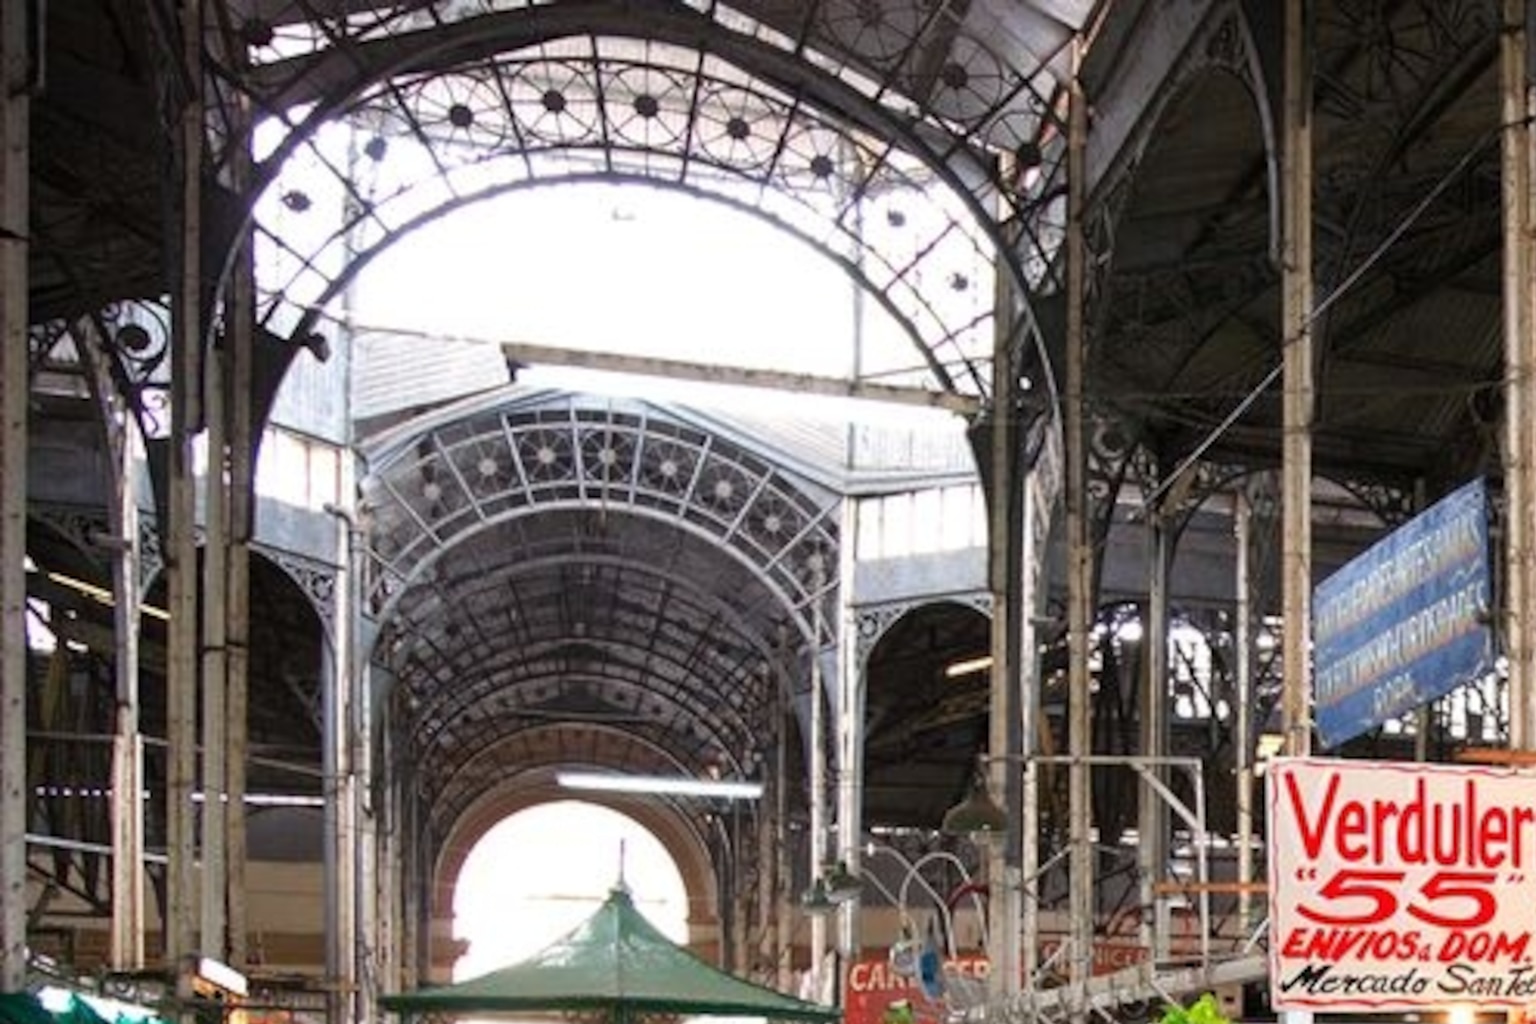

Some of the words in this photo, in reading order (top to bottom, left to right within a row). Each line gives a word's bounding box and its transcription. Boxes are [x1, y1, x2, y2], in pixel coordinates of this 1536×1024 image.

[1282, 928, 1422, 962] ENVIOS
[1437, 930, 1533, 963] DOM.
[1280, 963, 1432, 995] Mercado
